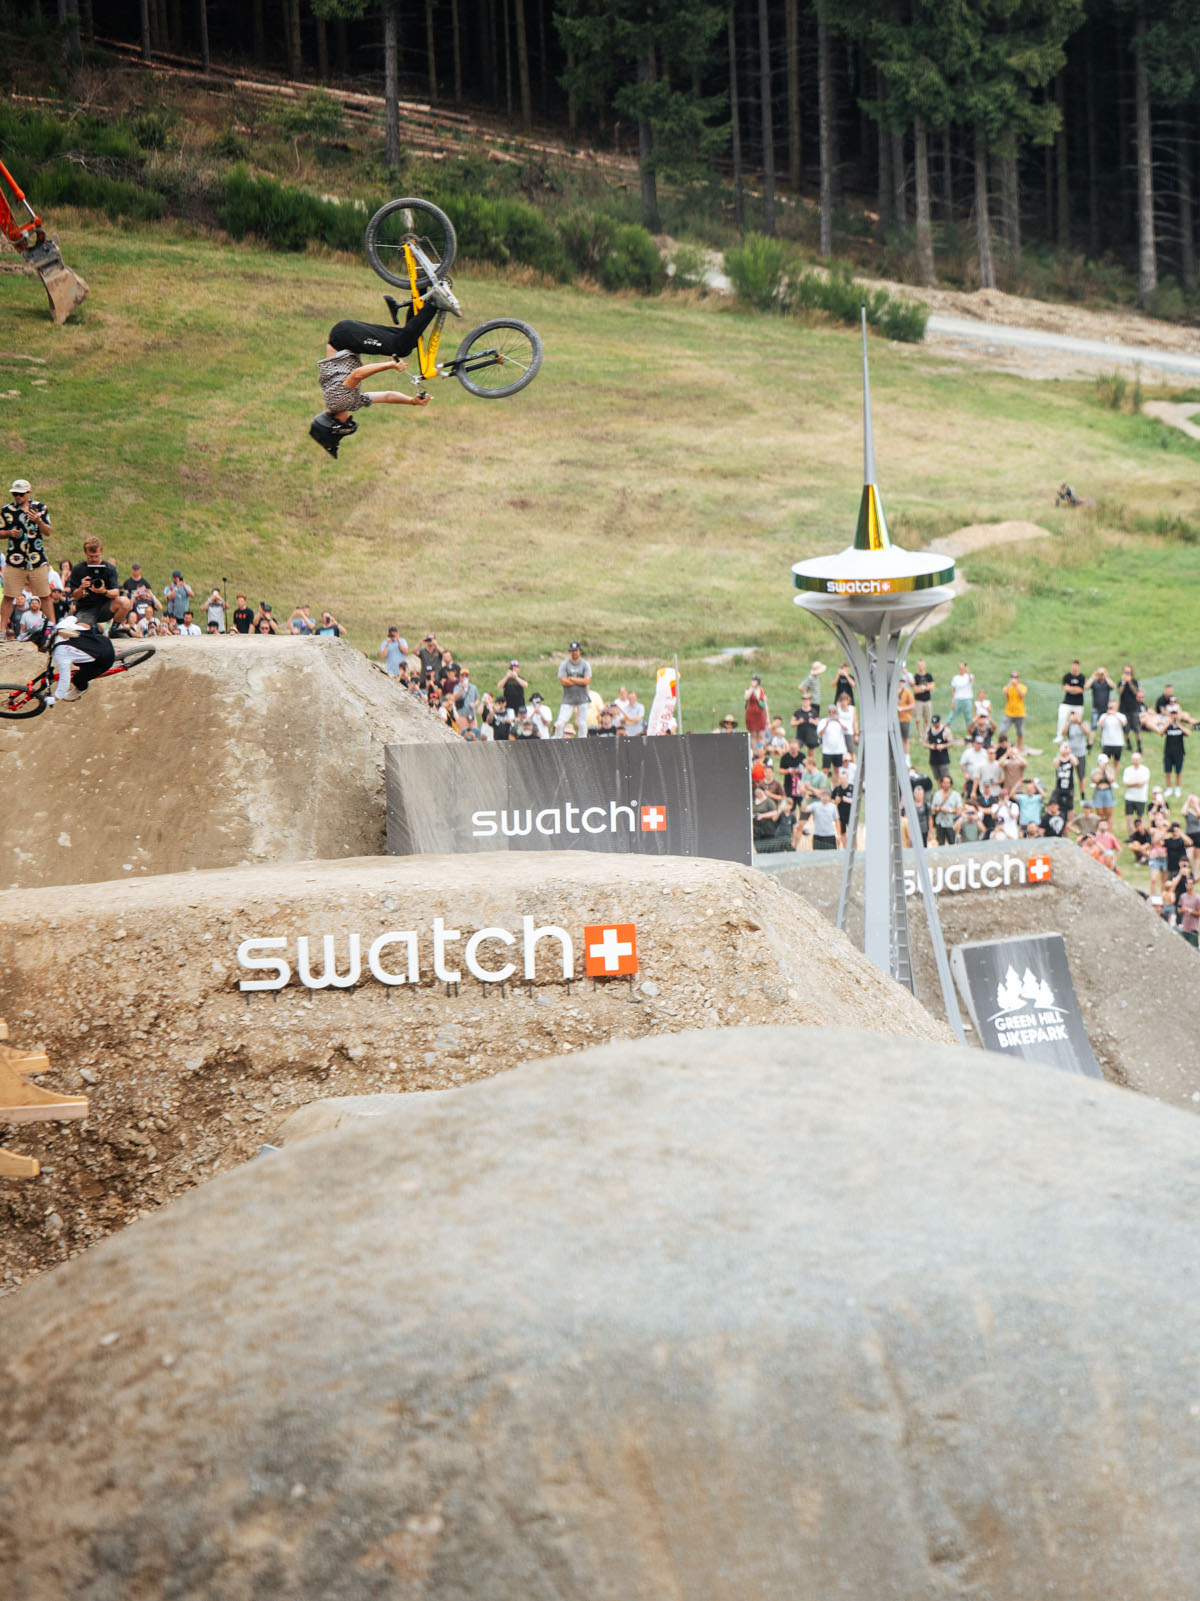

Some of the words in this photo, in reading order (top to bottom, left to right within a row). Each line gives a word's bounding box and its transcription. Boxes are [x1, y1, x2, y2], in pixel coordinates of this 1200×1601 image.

[826, 580, 881, 593] swatch
[236, 915, 574, 992] swatch
[995, 1014, 1037, 1031] GREEN
[1038, 1010, 1064, 1025] HILL
[998, 1025, 1068, 1047] BIKEPARK
